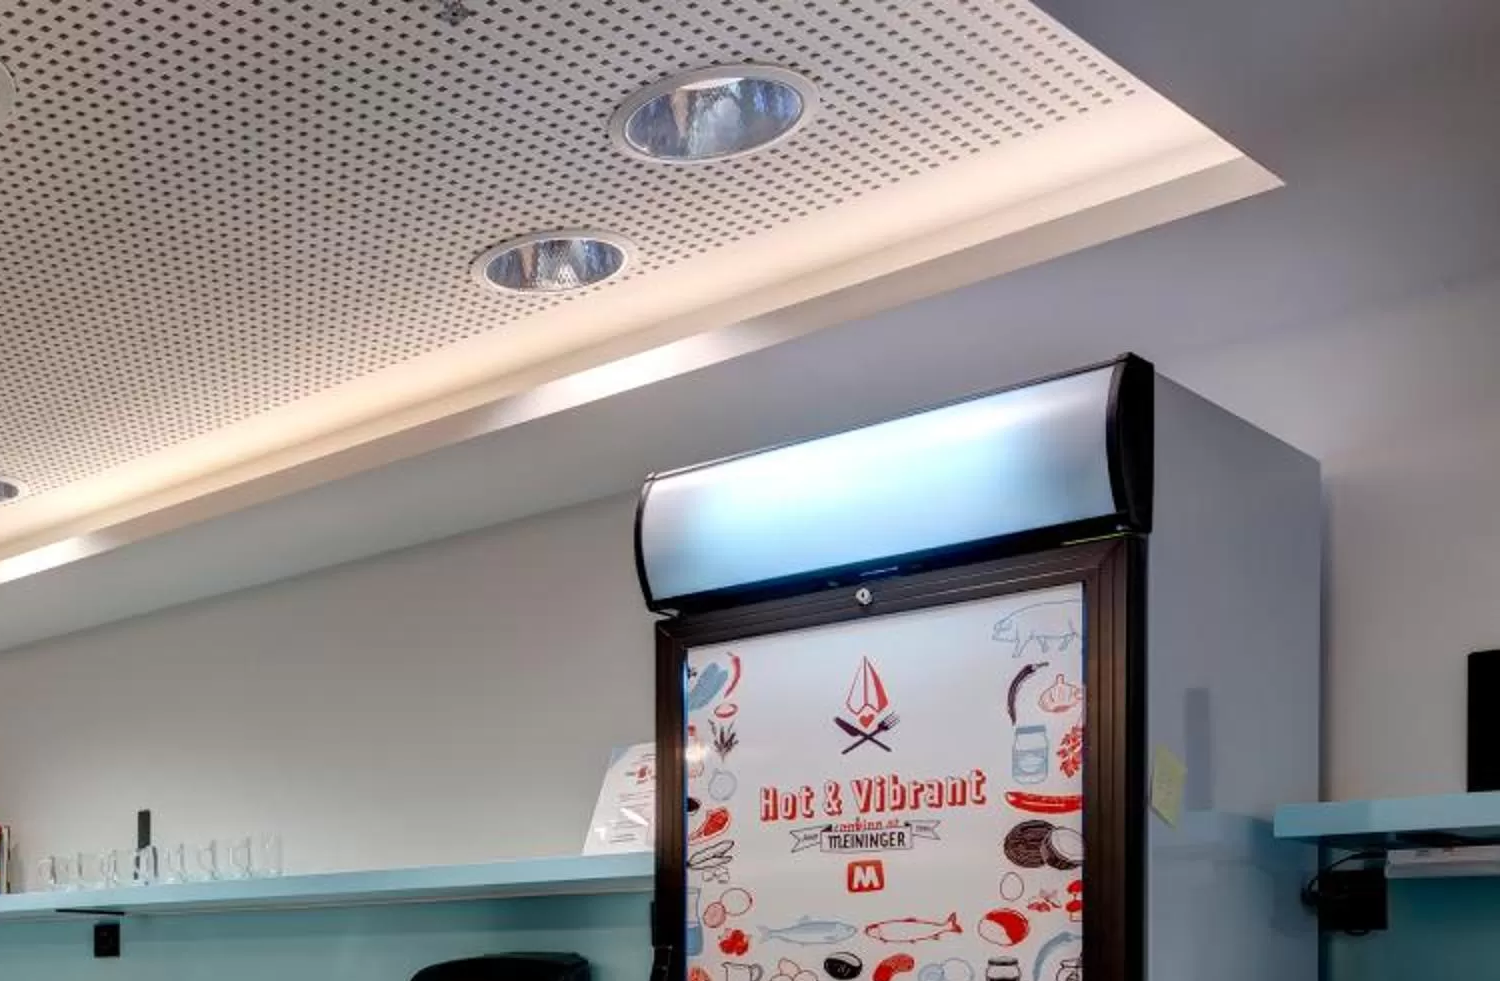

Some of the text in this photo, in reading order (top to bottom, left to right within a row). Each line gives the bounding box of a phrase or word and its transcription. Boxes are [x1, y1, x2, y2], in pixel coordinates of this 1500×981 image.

[760, 768, 988, 822] Hot & Vibrant
[827, 831, 906, 849] MEININGER
[851, 864, 882, 890] M
